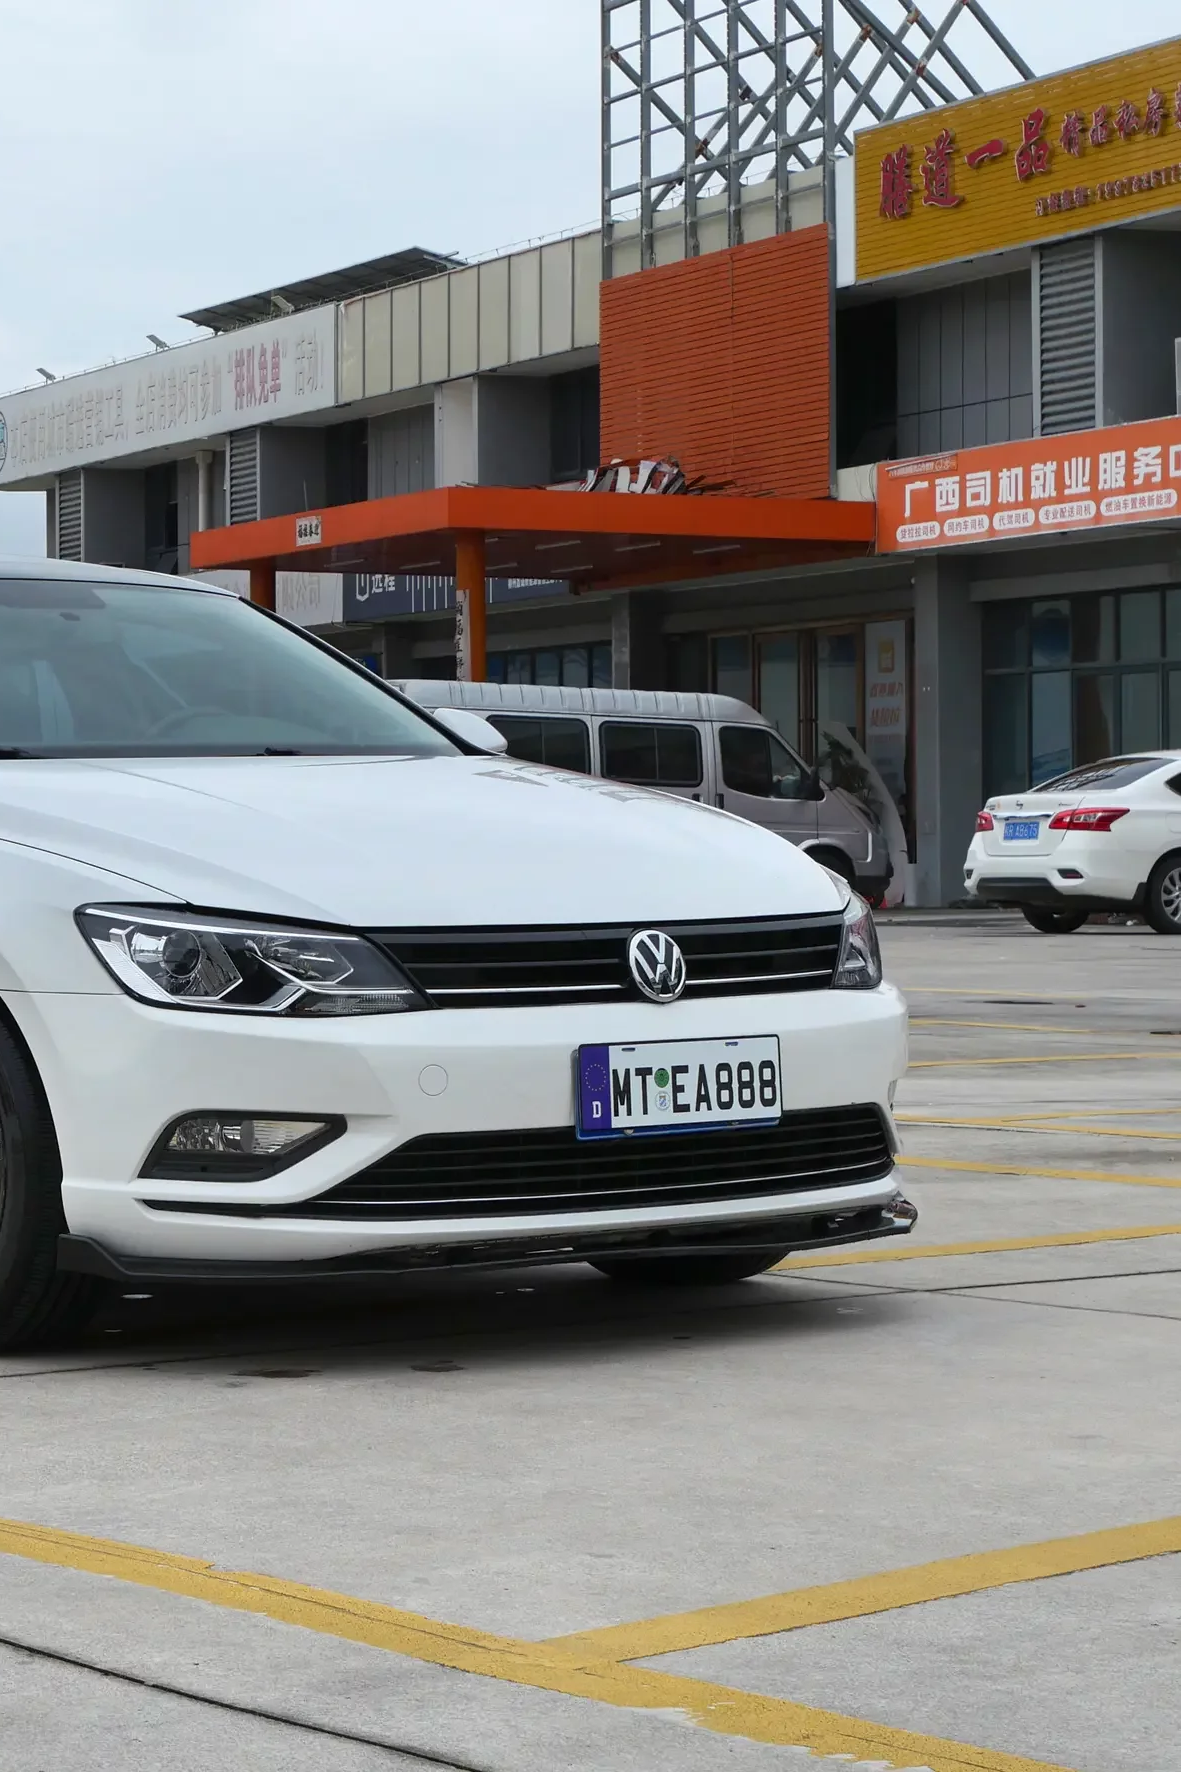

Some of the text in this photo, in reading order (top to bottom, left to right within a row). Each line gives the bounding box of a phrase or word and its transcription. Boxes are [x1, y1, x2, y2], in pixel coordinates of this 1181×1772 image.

[1060, 82, 1181, 158] 精品私房
[592, 1059, 777, 1118] D MT EA888
